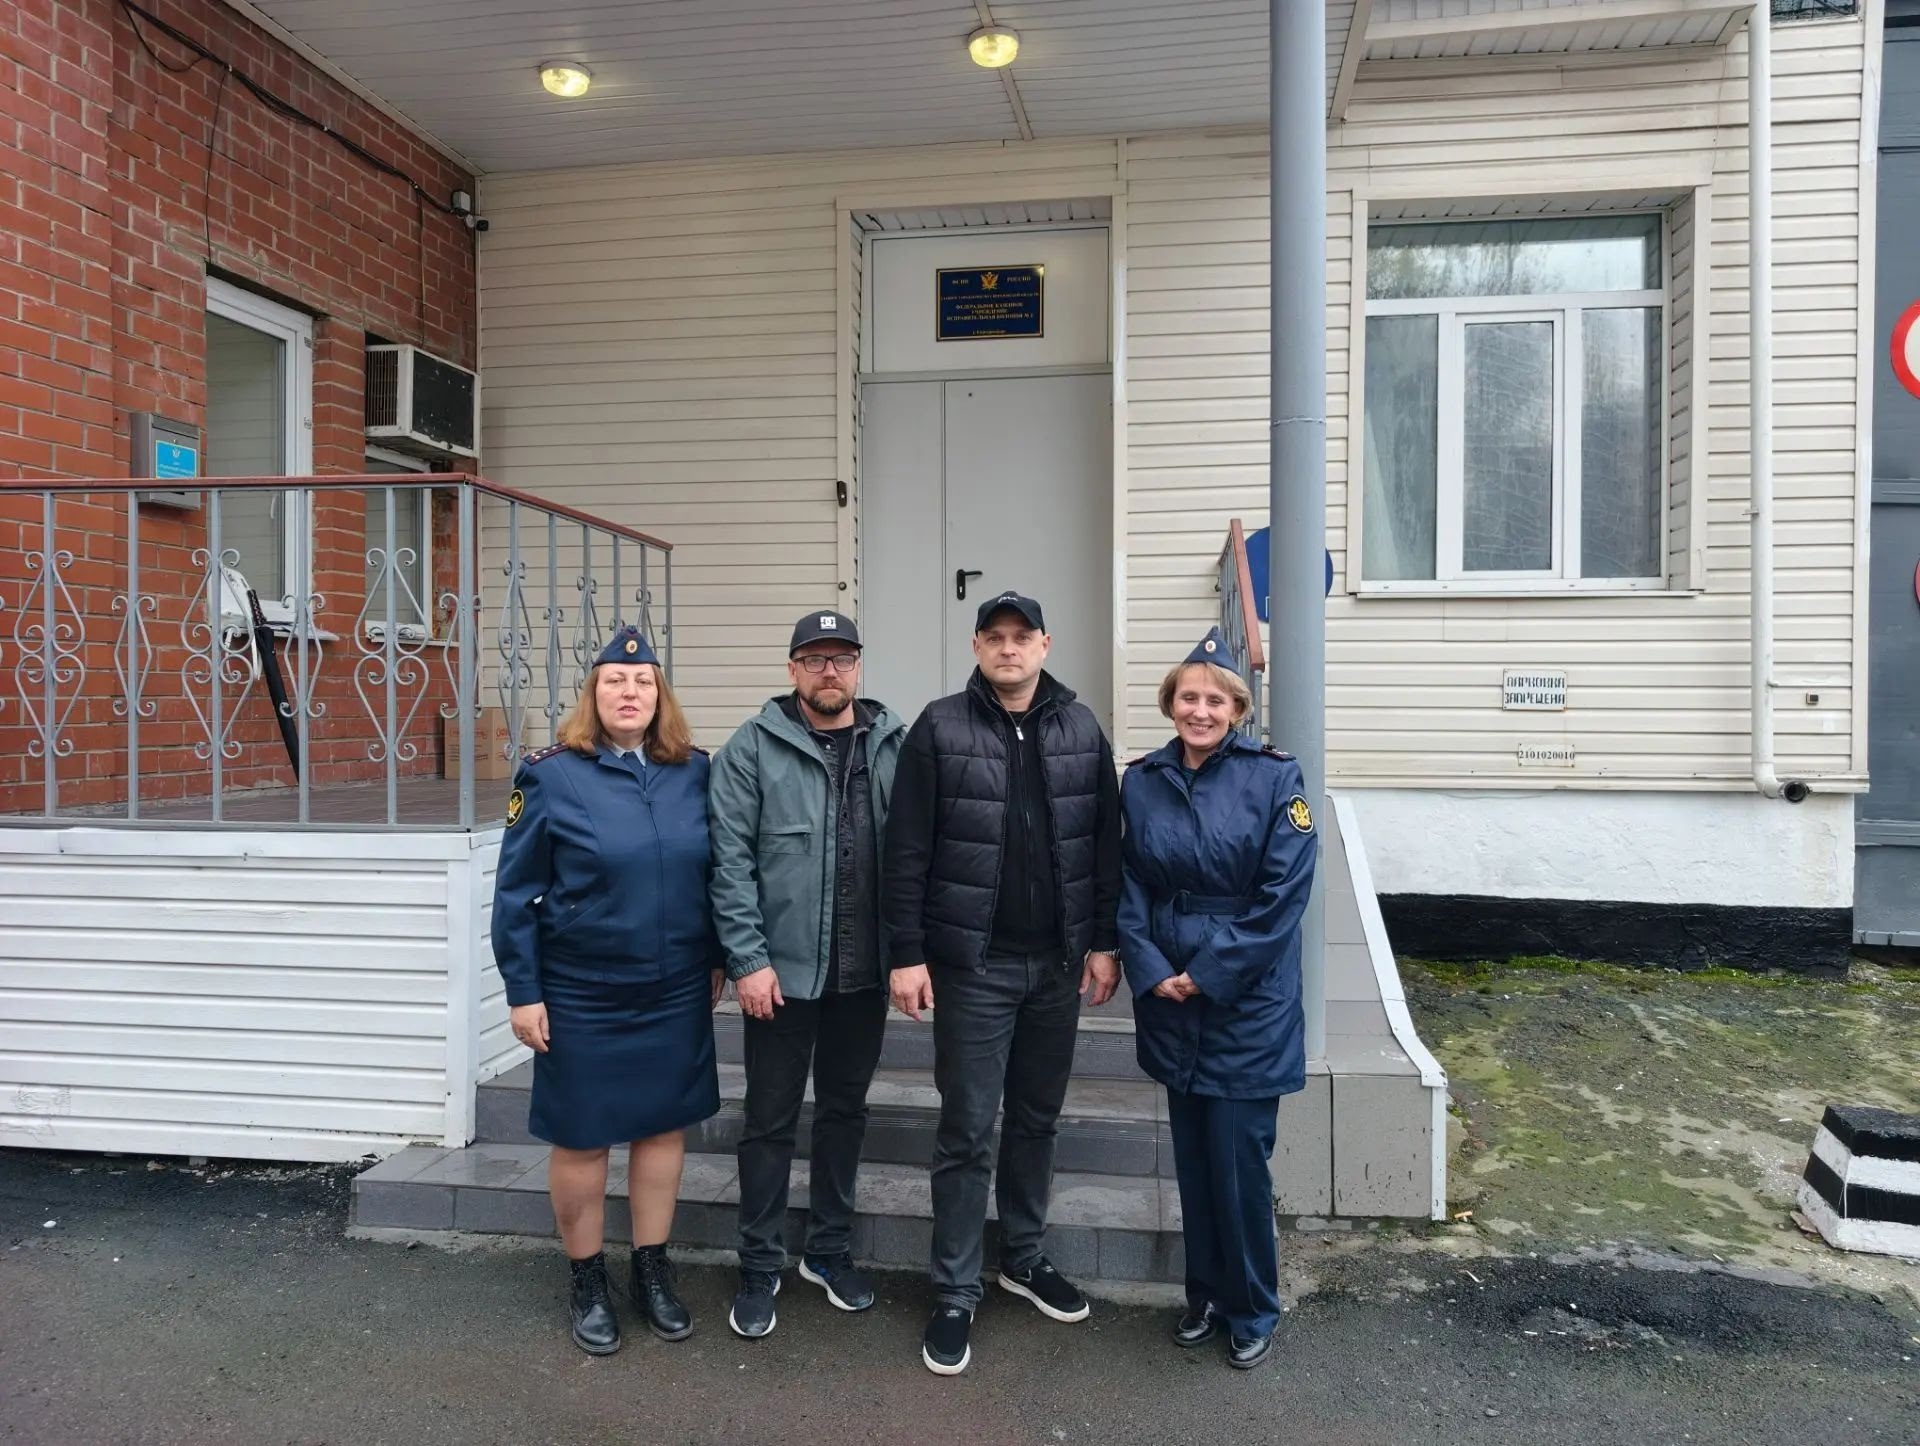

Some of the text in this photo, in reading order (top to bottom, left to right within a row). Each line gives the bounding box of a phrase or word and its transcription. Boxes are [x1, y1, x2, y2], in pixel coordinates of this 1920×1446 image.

[1507, 677, 1565, 688] ПАРКОВКА
[1505, 692, 1565, 704] ЗАПРЕЩЕНА
[1519, 750, 1575, 760] 2101020010
